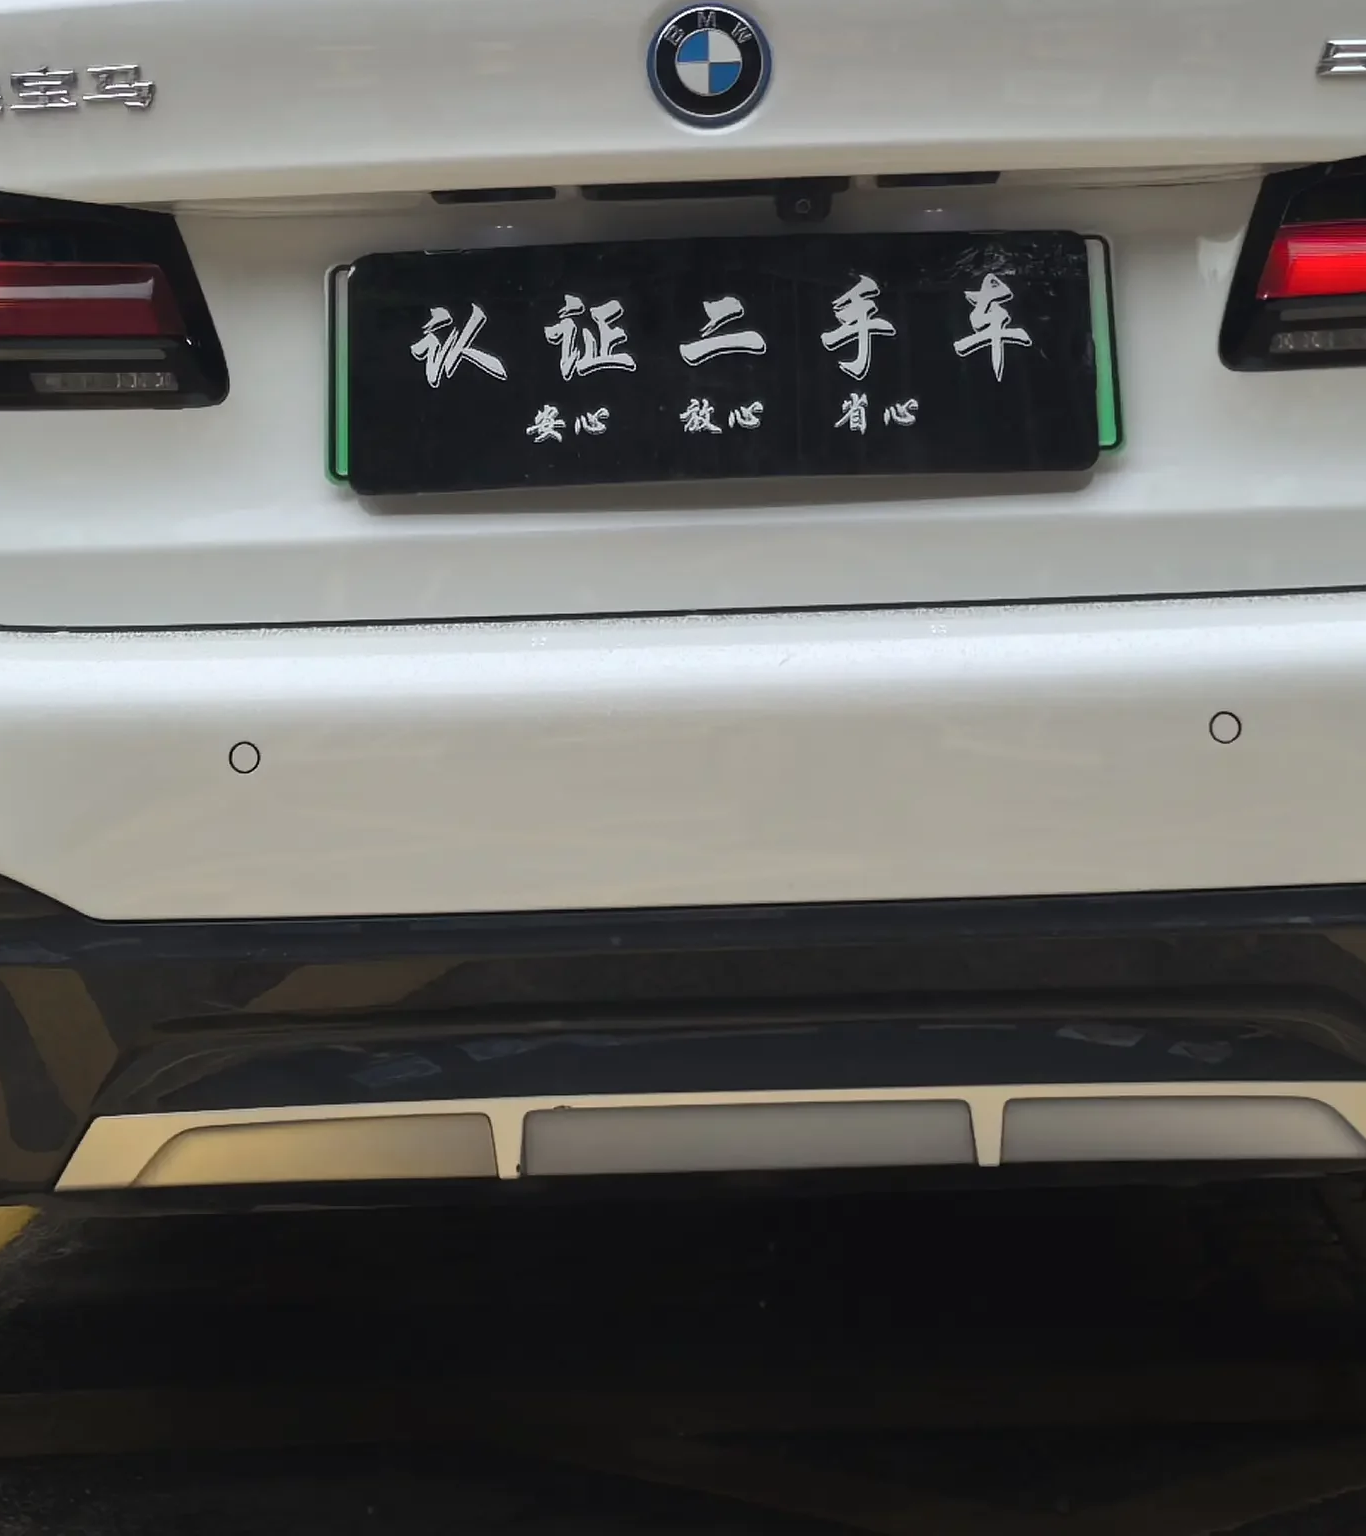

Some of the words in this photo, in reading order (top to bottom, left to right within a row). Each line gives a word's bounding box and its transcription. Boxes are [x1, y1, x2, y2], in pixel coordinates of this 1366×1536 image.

[664, 11, 753, 46] BMW
[410, 273, 1033, 387] 认证二手车
[527, 404, 610, 443] 安心
[680, 398, 764, 434] 放心
[834, 393, 919, 435] 省心
